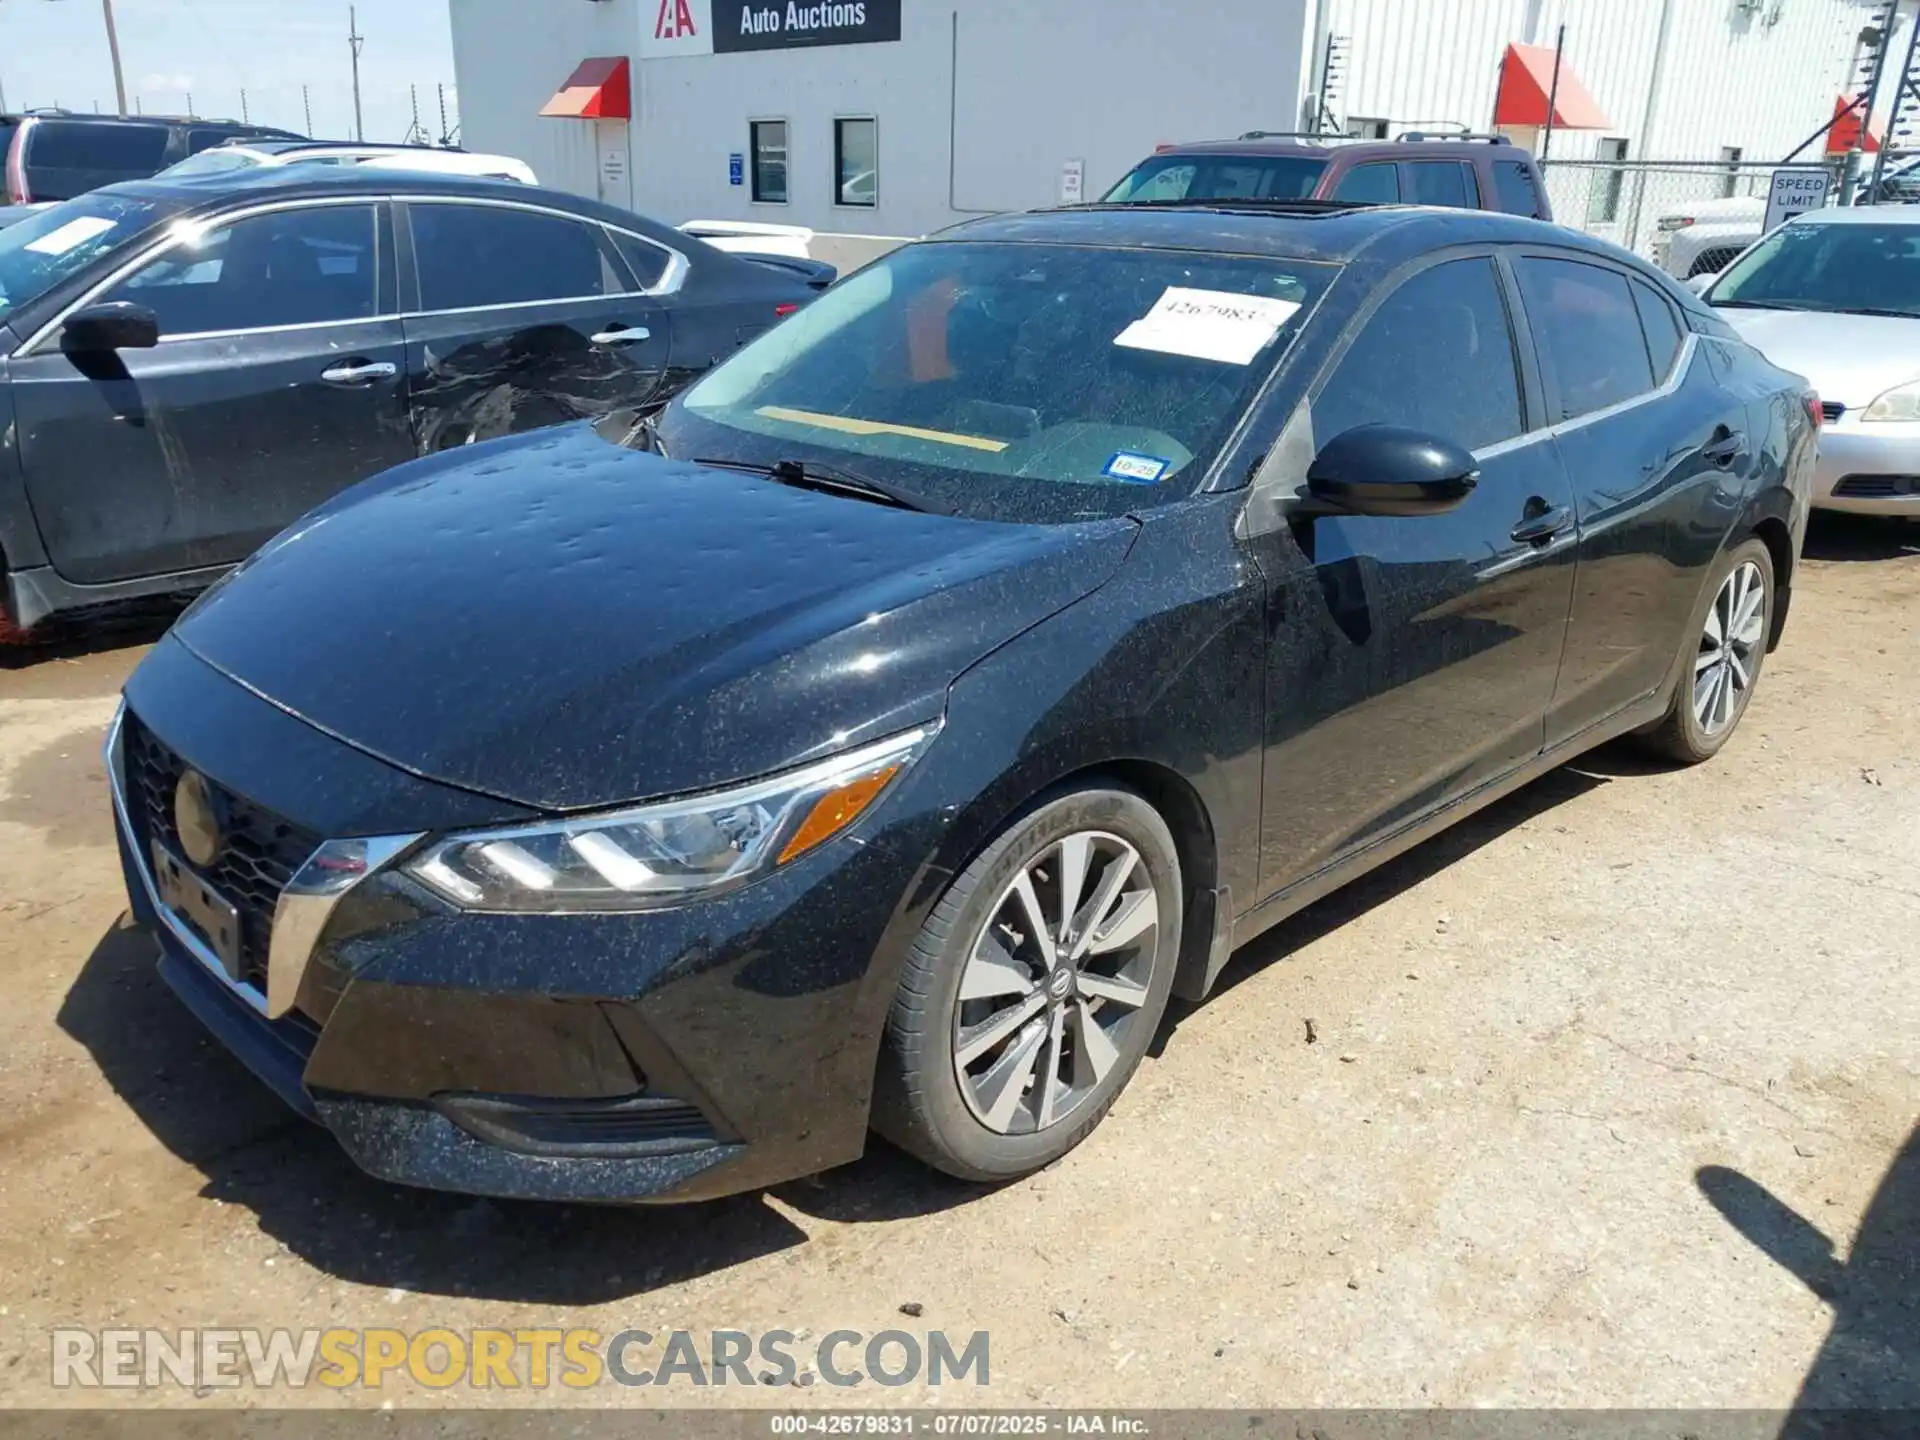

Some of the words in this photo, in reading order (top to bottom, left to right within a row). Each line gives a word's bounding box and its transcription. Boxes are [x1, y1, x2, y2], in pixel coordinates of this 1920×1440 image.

[741, 6, 779, 34] Auto
[785, 0, 866, 31] Auctions
[1775, 179, 1824, 190] SPEED
[1777, 195, 1815, 207] LIMIT
